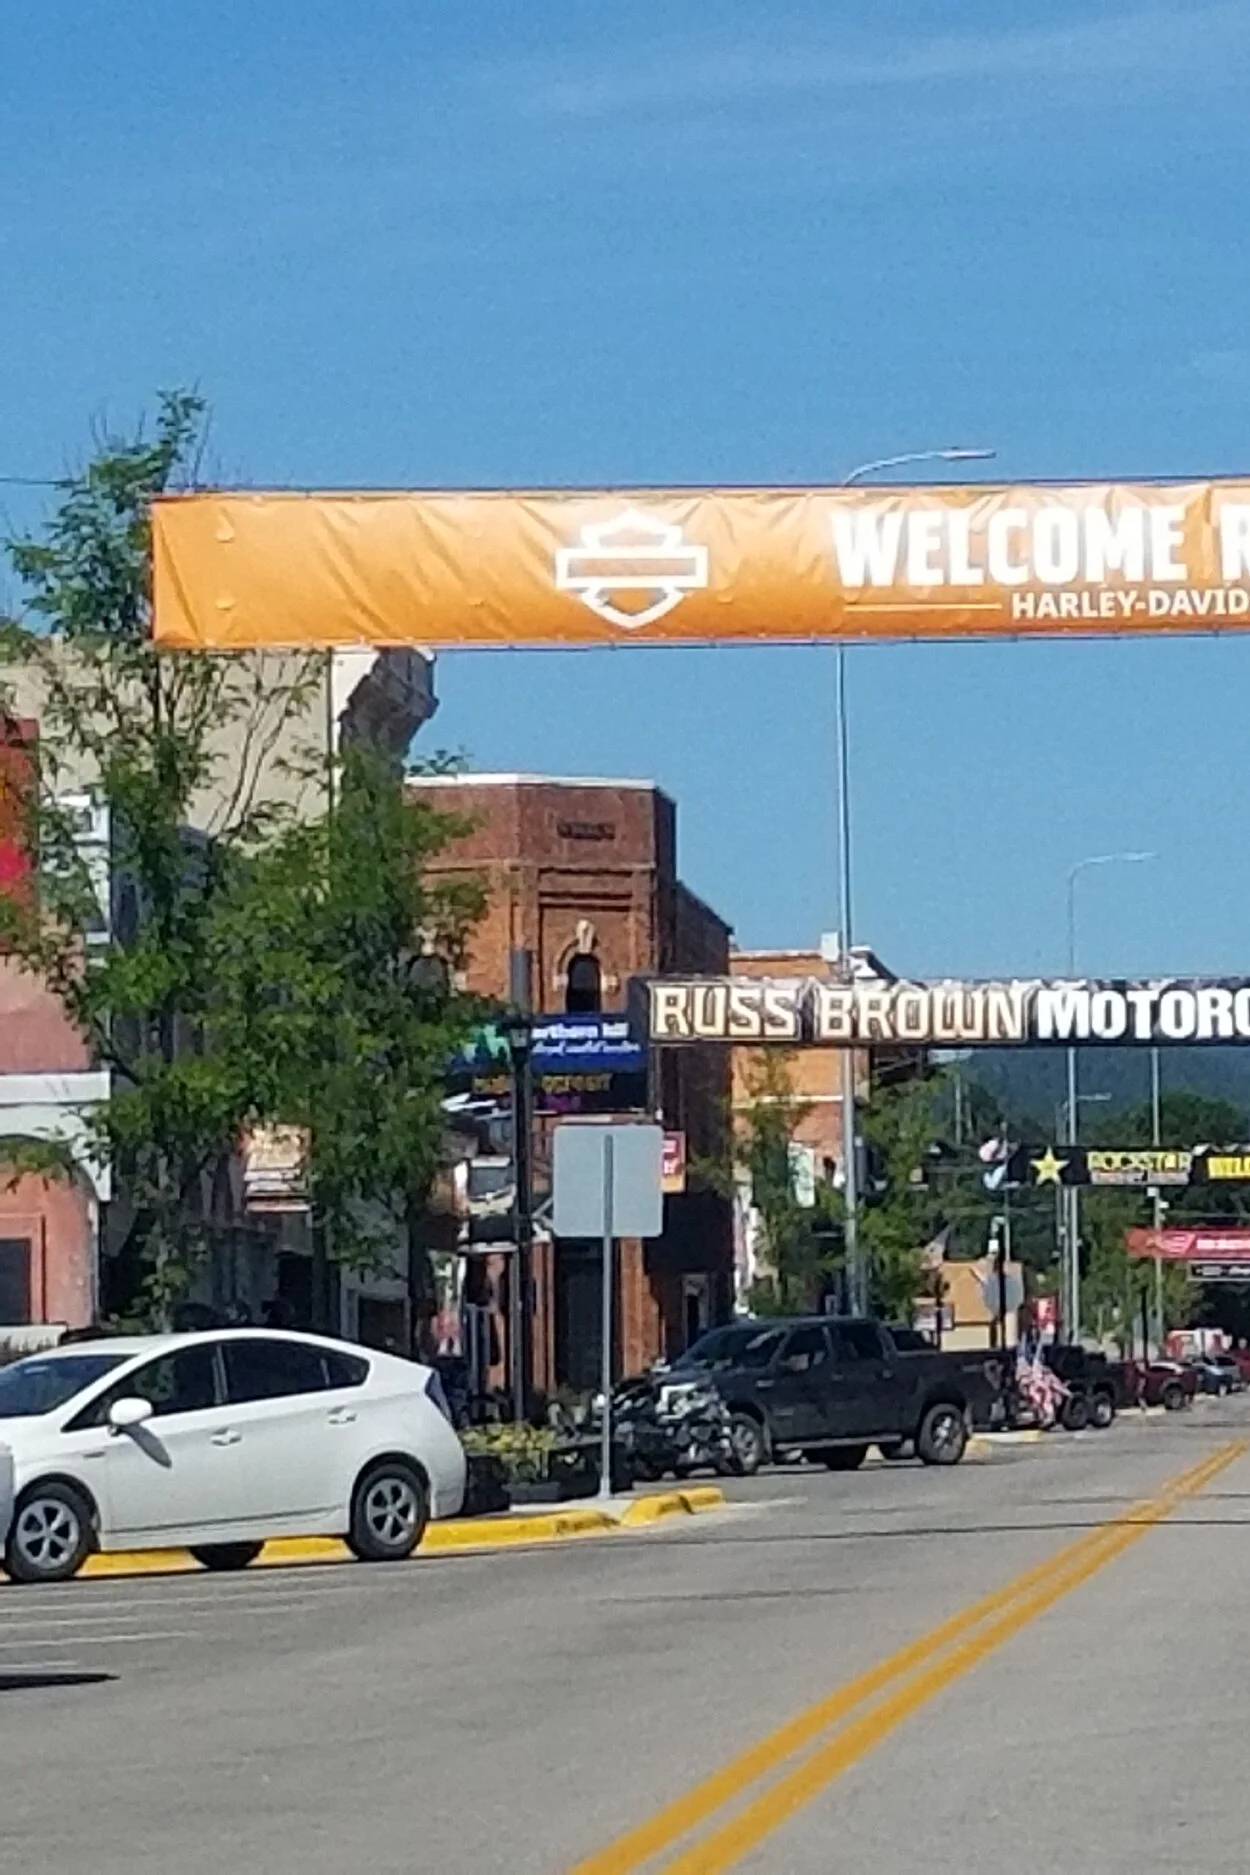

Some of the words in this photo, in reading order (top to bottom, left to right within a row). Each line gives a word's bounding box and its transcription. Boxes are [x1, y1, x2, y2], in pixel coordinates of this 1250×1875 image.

[830, 505, 1188, 588] WELCOME
[654, 985, 797, 1038] RUSS
[819, 988, 1023, 1040] BROWN
